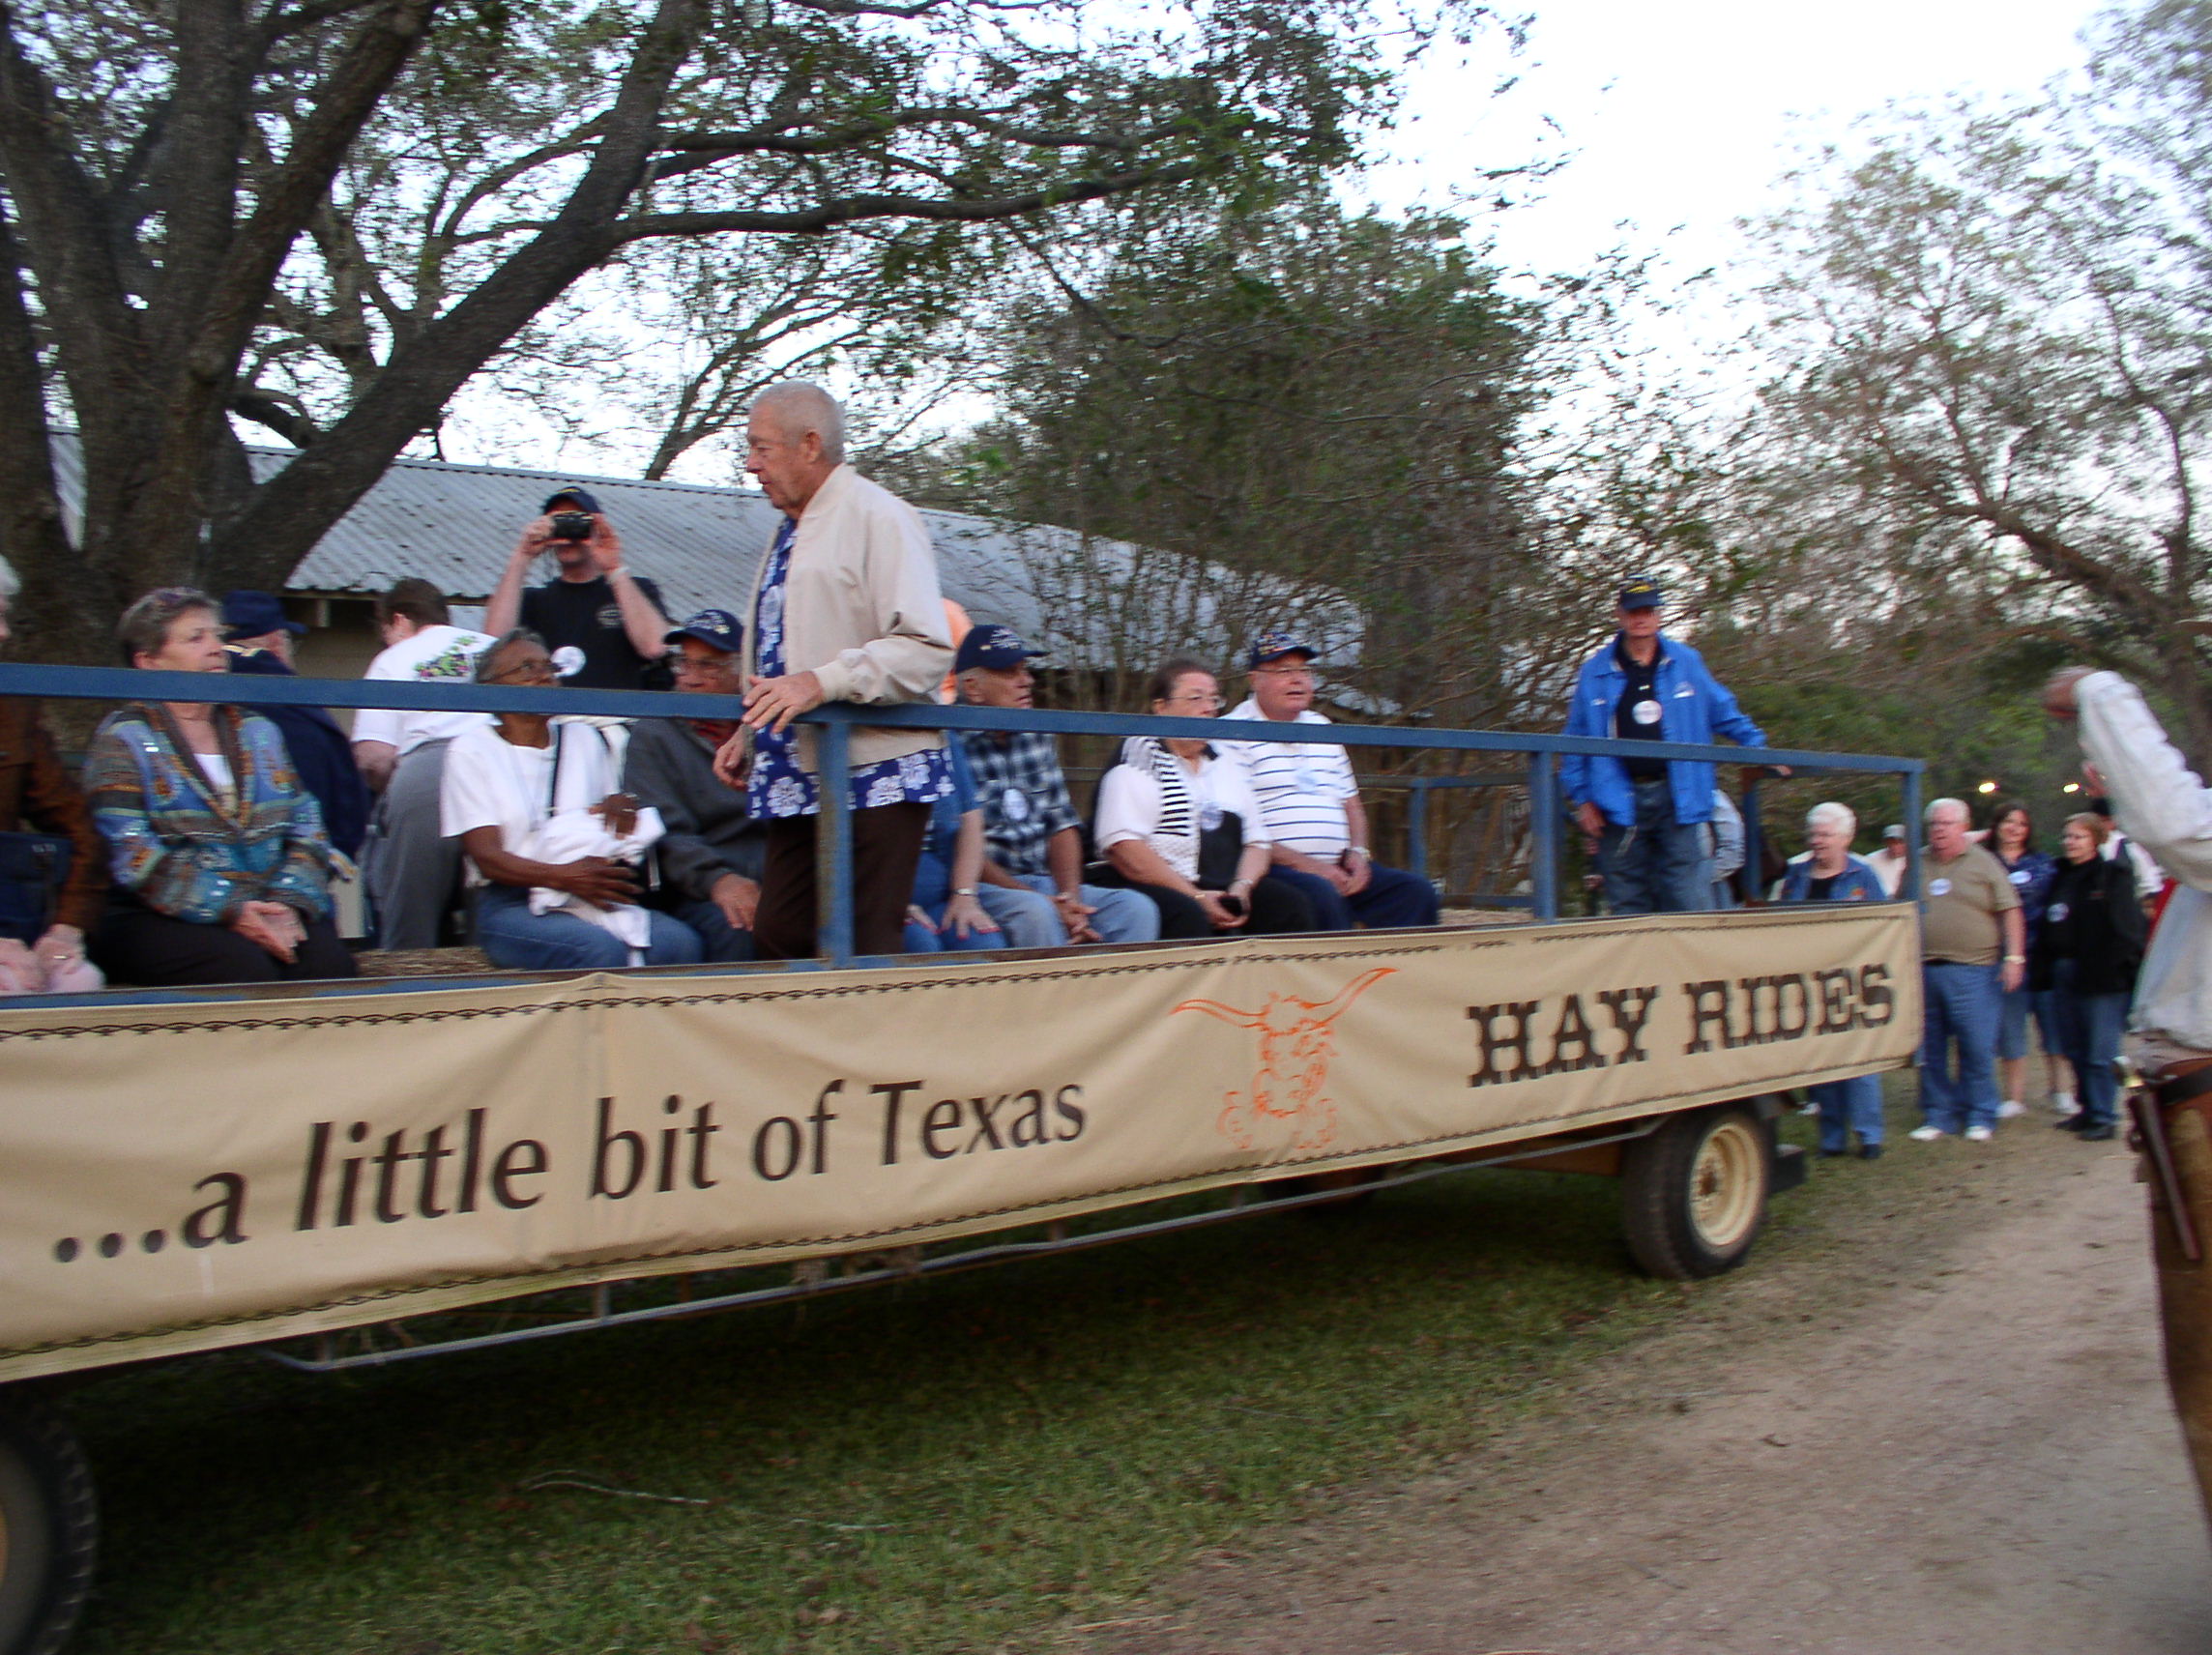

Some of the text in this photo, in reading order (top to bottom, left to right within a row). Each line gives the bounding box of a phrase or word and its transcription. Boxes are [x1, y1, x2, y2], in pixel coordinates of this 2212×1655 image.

[1467, 964, 1896, 1089] HAY RIDES
[295, 1106, 550, 1233] little
[589, 1093, 721, 1202] bit
[750, 1078, 847, 1182] of
[868, 1080, 1087, 1167] Texas
